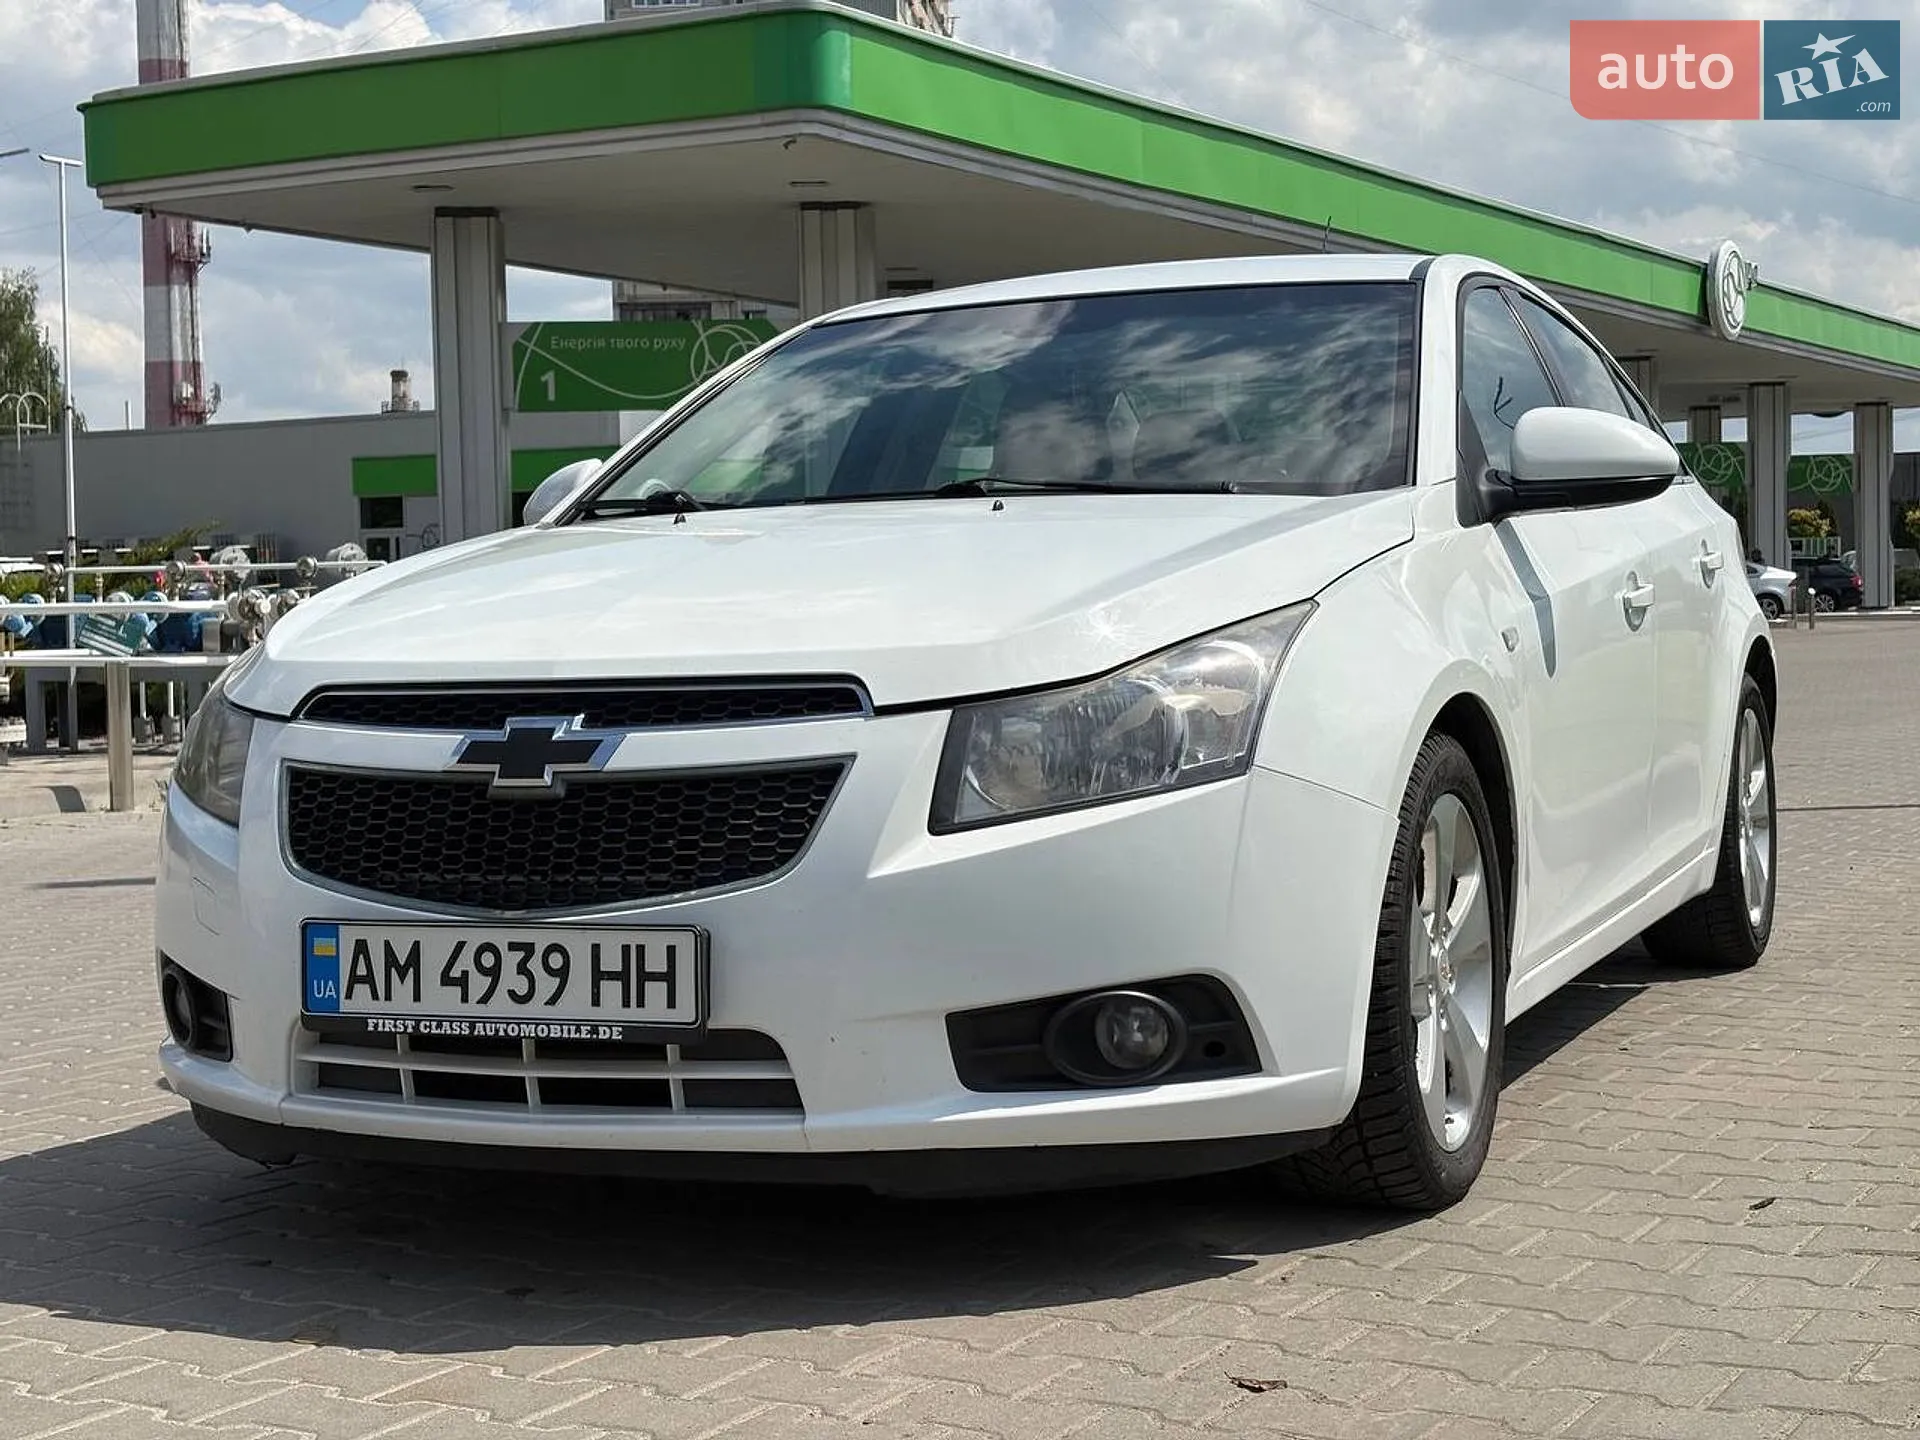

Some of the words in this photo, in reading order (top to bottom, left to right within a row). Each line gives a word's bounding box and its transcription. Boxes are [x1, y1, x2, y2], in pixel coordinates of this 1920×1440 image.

[550, 336, 606, 351] Енергія
[610, 337, 650, 349] твого
[653, 337, 686, 351] руху
[541, 370, 556, 401] 1
[344, 938, 422, 1002] AM
[440, 940, 571, 1006] 4939
[591, 943, 677, 1009] HH
[313, 979, 337, 999] UA
[367, 1018, 415, 1033] FIRST
[419, 1021, 470, 1035] CLASS
[473, 1022, 623, 1040] AUTOMOBILE.DE
